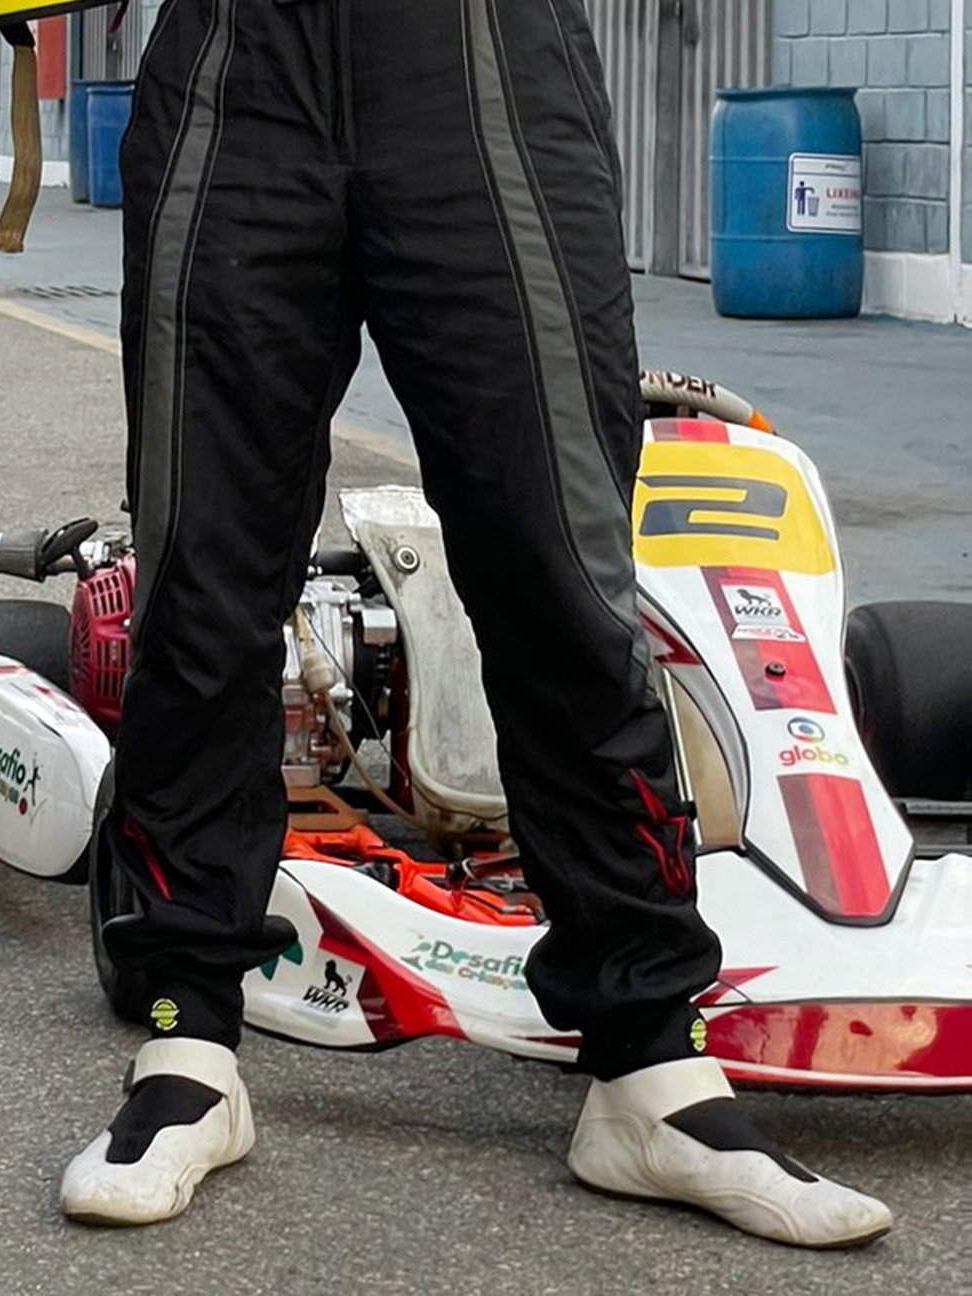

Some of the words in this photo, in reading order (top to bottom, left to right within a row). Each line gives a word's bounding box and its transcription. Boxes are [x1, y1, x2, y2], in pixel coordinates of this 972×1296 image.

[638, 475, 788, 540] 2
[734, 605, 782, 617] WKR
[779, 745, 848, 767] globo
[430, 940, 526, 977] Desafi
